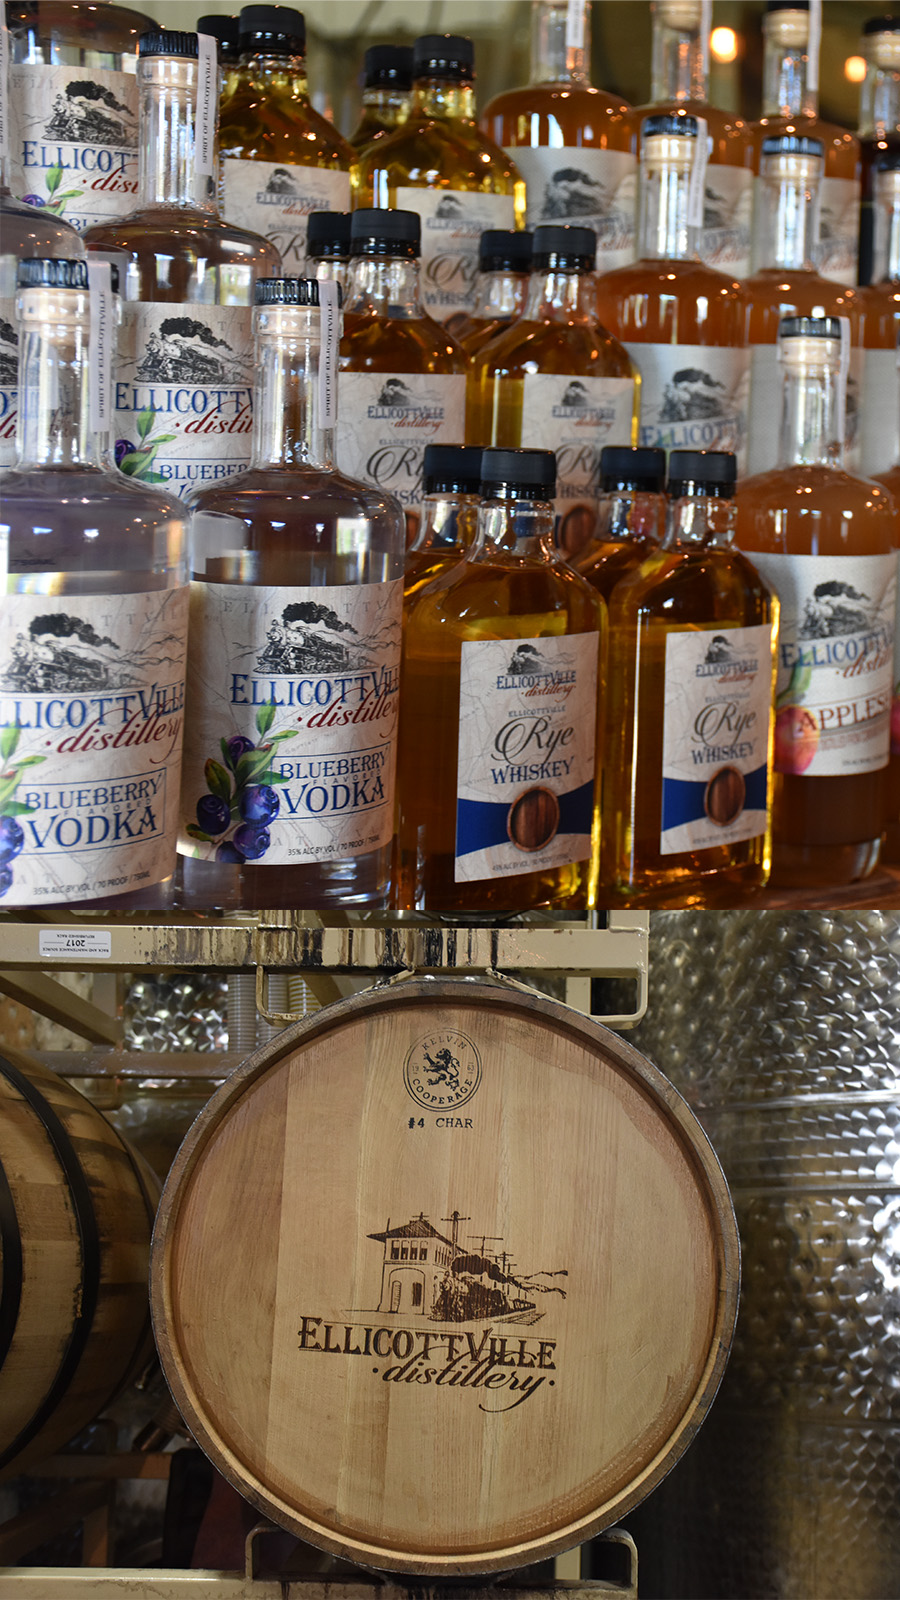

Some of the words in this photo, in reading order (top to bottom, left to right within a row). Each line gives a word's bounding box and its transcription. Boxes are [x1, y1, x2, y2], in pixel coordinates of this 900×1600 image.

[203, 54, 212, 121] ELLICOTTVILLE
[203, 122, 209, 134] OF
[97, 290, 106, 368] ELLICOTTVILLE
[325, 300, 334, 371] ELLICOTTVILLE
[98, 371, 105, 384] OF
[325, 373, 332, 385] OF
[496, 670, 577, 690] ELLICOTTVILLE
[521, 678, 577, 703] distillery
[508, 705, 566, 718] ELLICOTTVILLE
[690, 701, 756, 747] Rye
[490, 715, 574, 767] Rye
[691, 742, 755, 764] WHISKEY
[280, 748, 387, 779] BLUEBERRY
[490, 756, 575, 785] WHISKEY
[312, 769, 382, 786] FLAVORED
[25, 772, 163, 811] BLUEBERRY
[281, 776, 385, 814] VODKA
[64, 798, 152, 817] FLAVORED
[26, 805, 158, 848] VODKA
[288, 848, 301, 856] 35%
[302, 847, 314, 855] ALC
[324, 845, 335, 853] VOL
[348, 839, 364, 848] PROOF
[51, 885, 65, 894] ALC
[76, 883, 91, 892] VOL
[107, 876, 128, 886] PROOF
[66, 939, 85, 947] 2017
[422, 1035, 467, 1051] KELVIN
[412, 1078, 473, 1105] COOPERAGE
[408, 1117, 425, 1129] #4
[435, 1117, 474, 1129] CHAR
[298, 1315, 557, 1370] ELLICOTTVILLE
[379, 1345, 549, 1413] distillery
